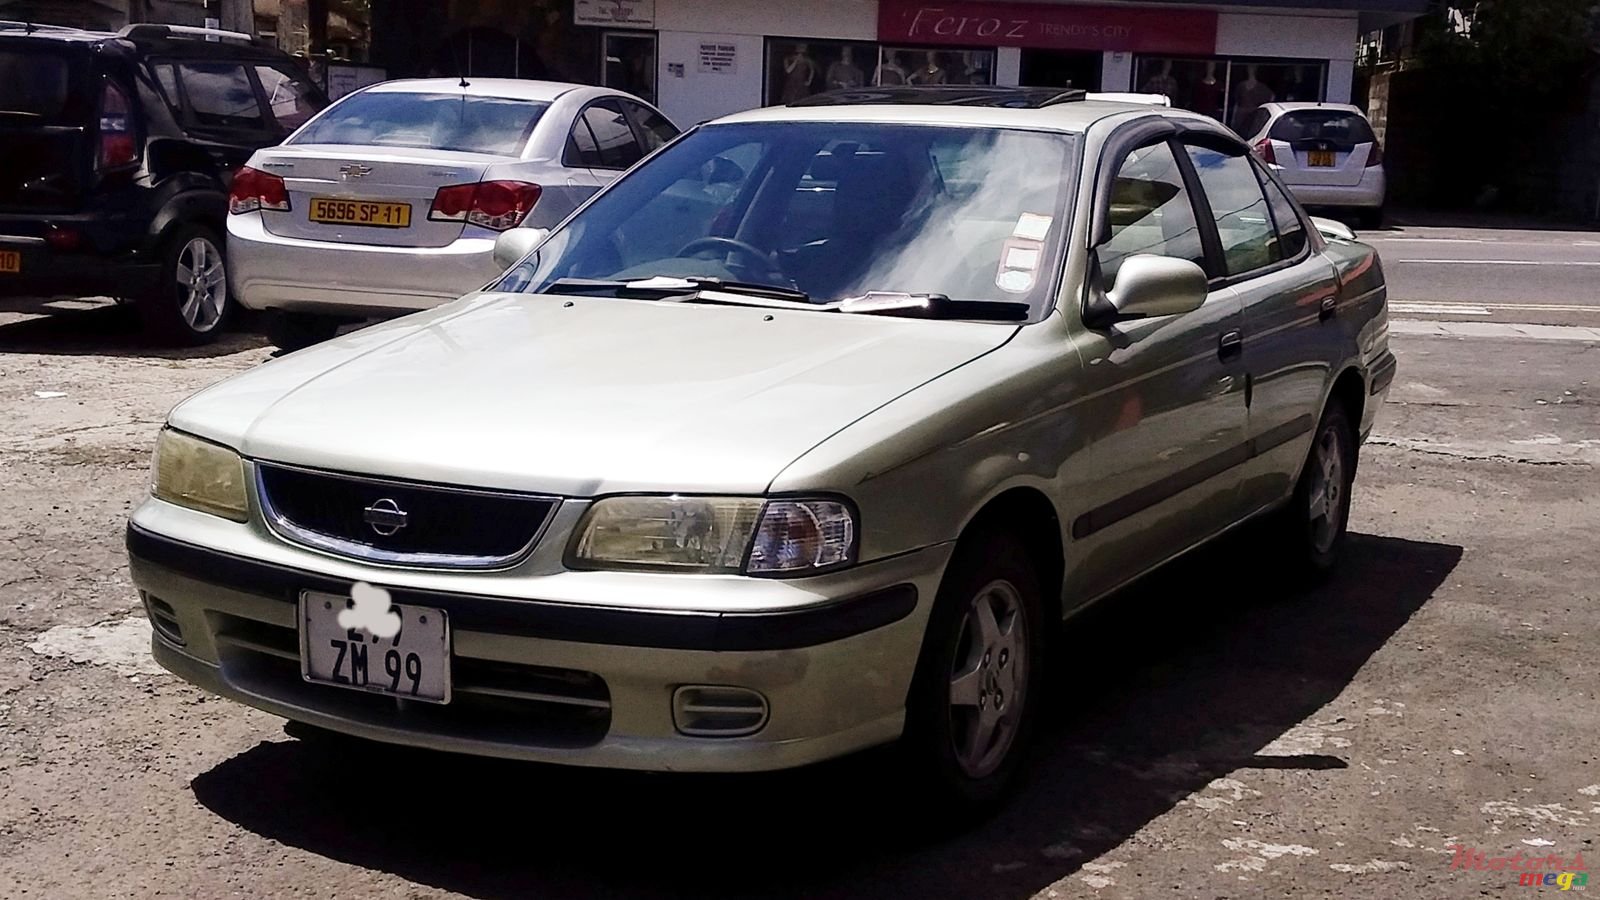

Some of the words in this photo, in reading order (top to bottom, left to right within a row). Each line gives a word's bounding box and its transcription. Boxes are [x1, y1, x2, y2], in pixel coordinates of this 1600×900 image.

[903, 8, 1029, 38] Feroz
[1103, 25, 1132, 38] CITY
[317, 203, 356, 221] 5696
[359, 204, 380, 222] SP
[331, 639, 369, 685] ZM
[385, 649, 422, 695] 99
